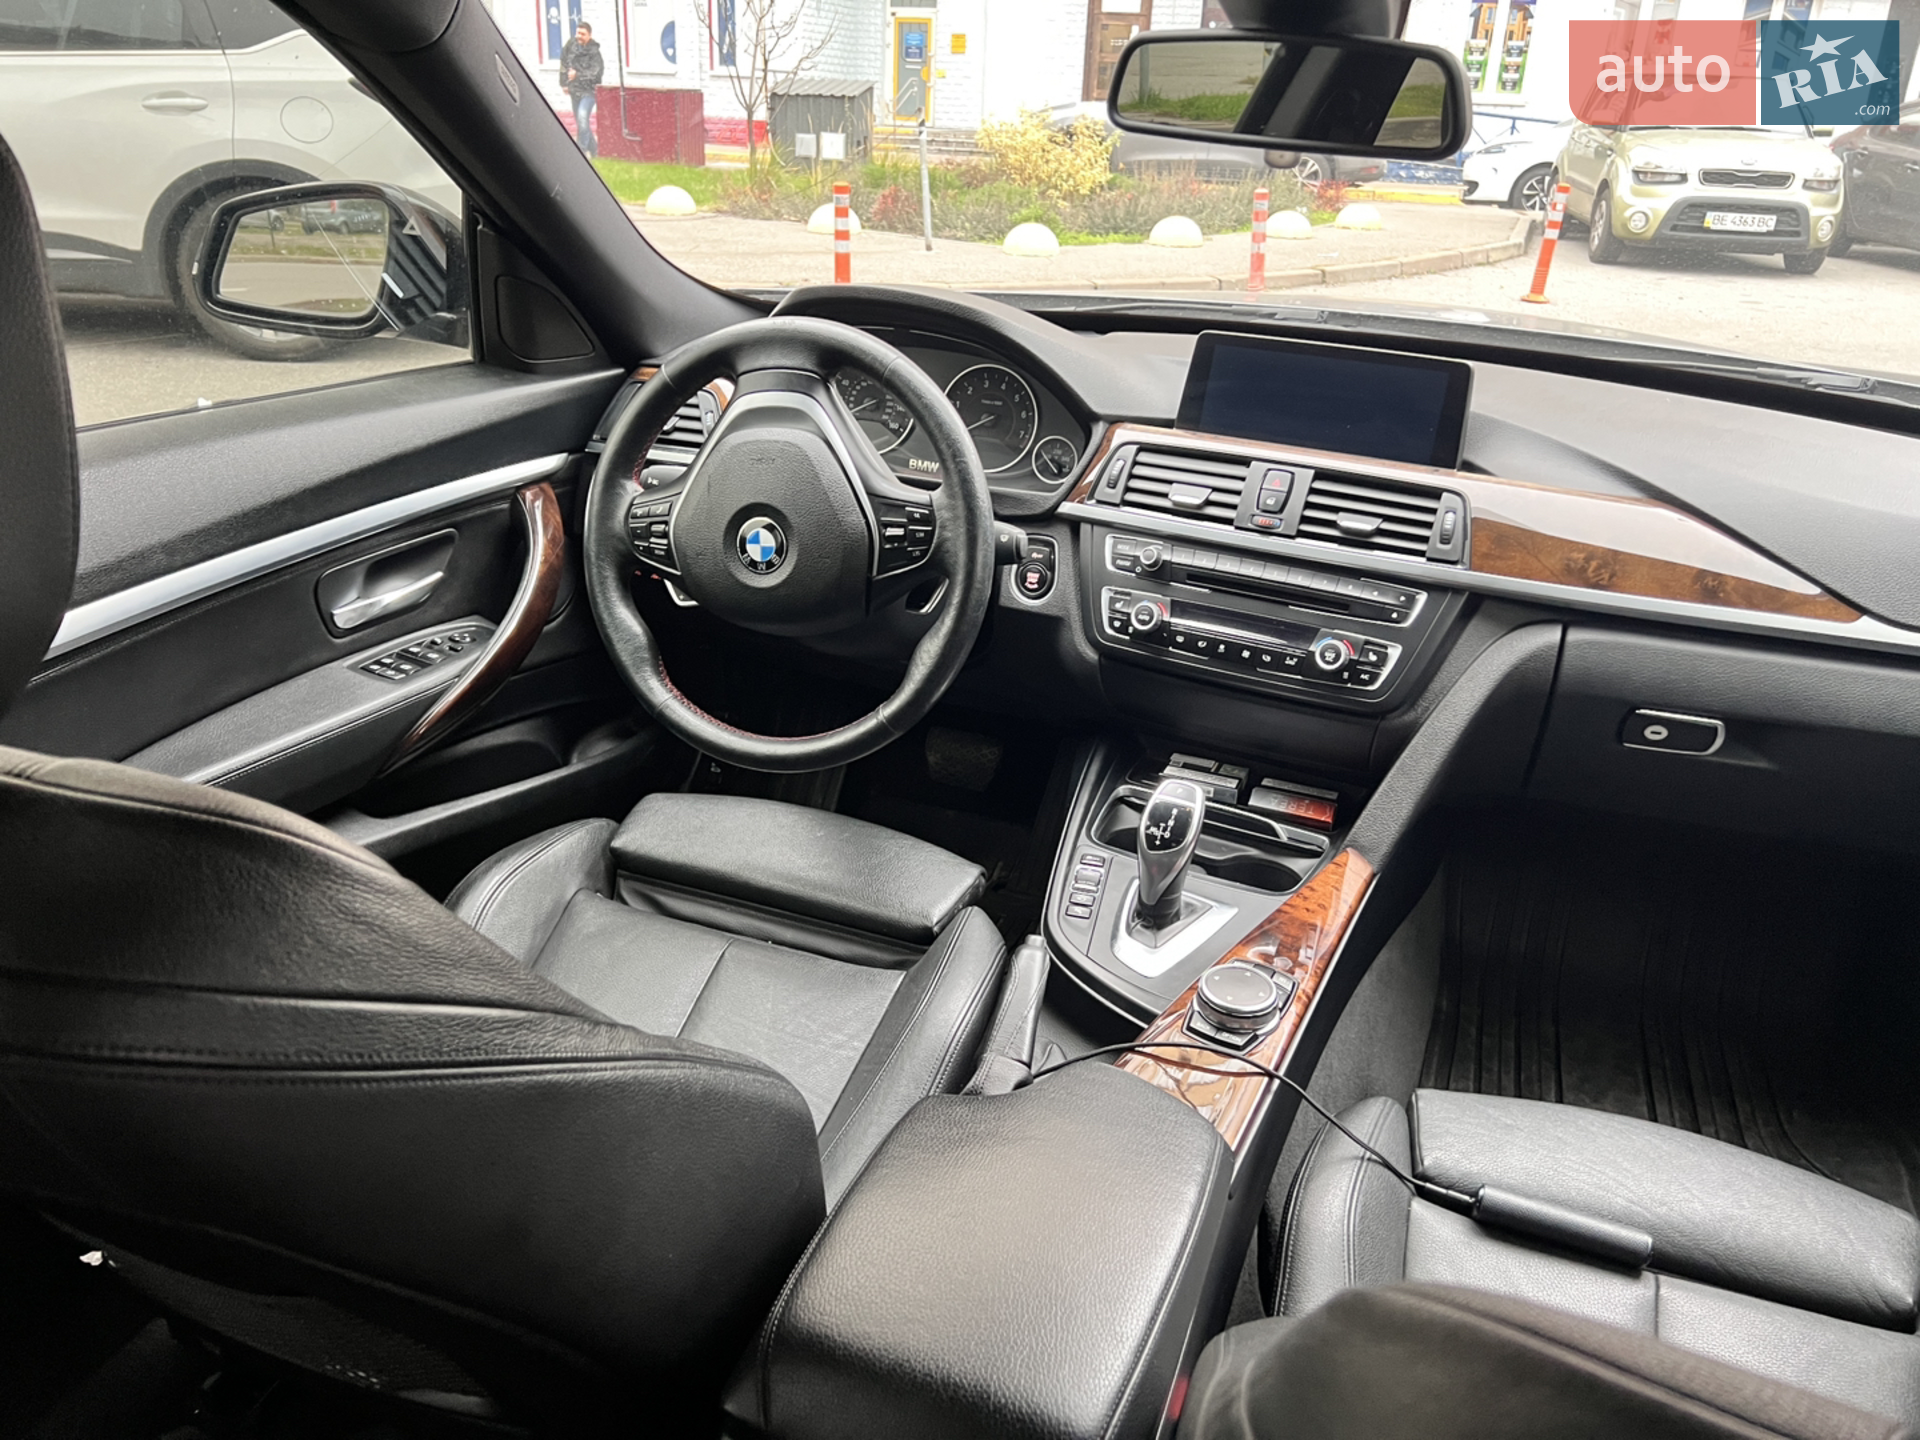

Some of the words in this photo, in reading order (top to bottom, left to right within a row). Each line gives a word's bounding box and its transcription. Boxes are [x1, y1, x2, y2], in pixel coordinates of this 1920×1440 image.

[1712, 214, 1729, 226] BE
[1731, 215, 1757, 227] 4363
[1757, 216, 1774, 228] BC
[983, 380, 989, 388] 3
[1000, 382, 1006, 390] 4
[967, 386, 973, 395] 2
[1014, 394, 1020, 402] 5
[1021, 410, 1027, 419] 6
[1019, 430, 1025, 439] 7
[908, 458, 940, 473] BMW
[1271, 797, 1315, 815] TEREA
